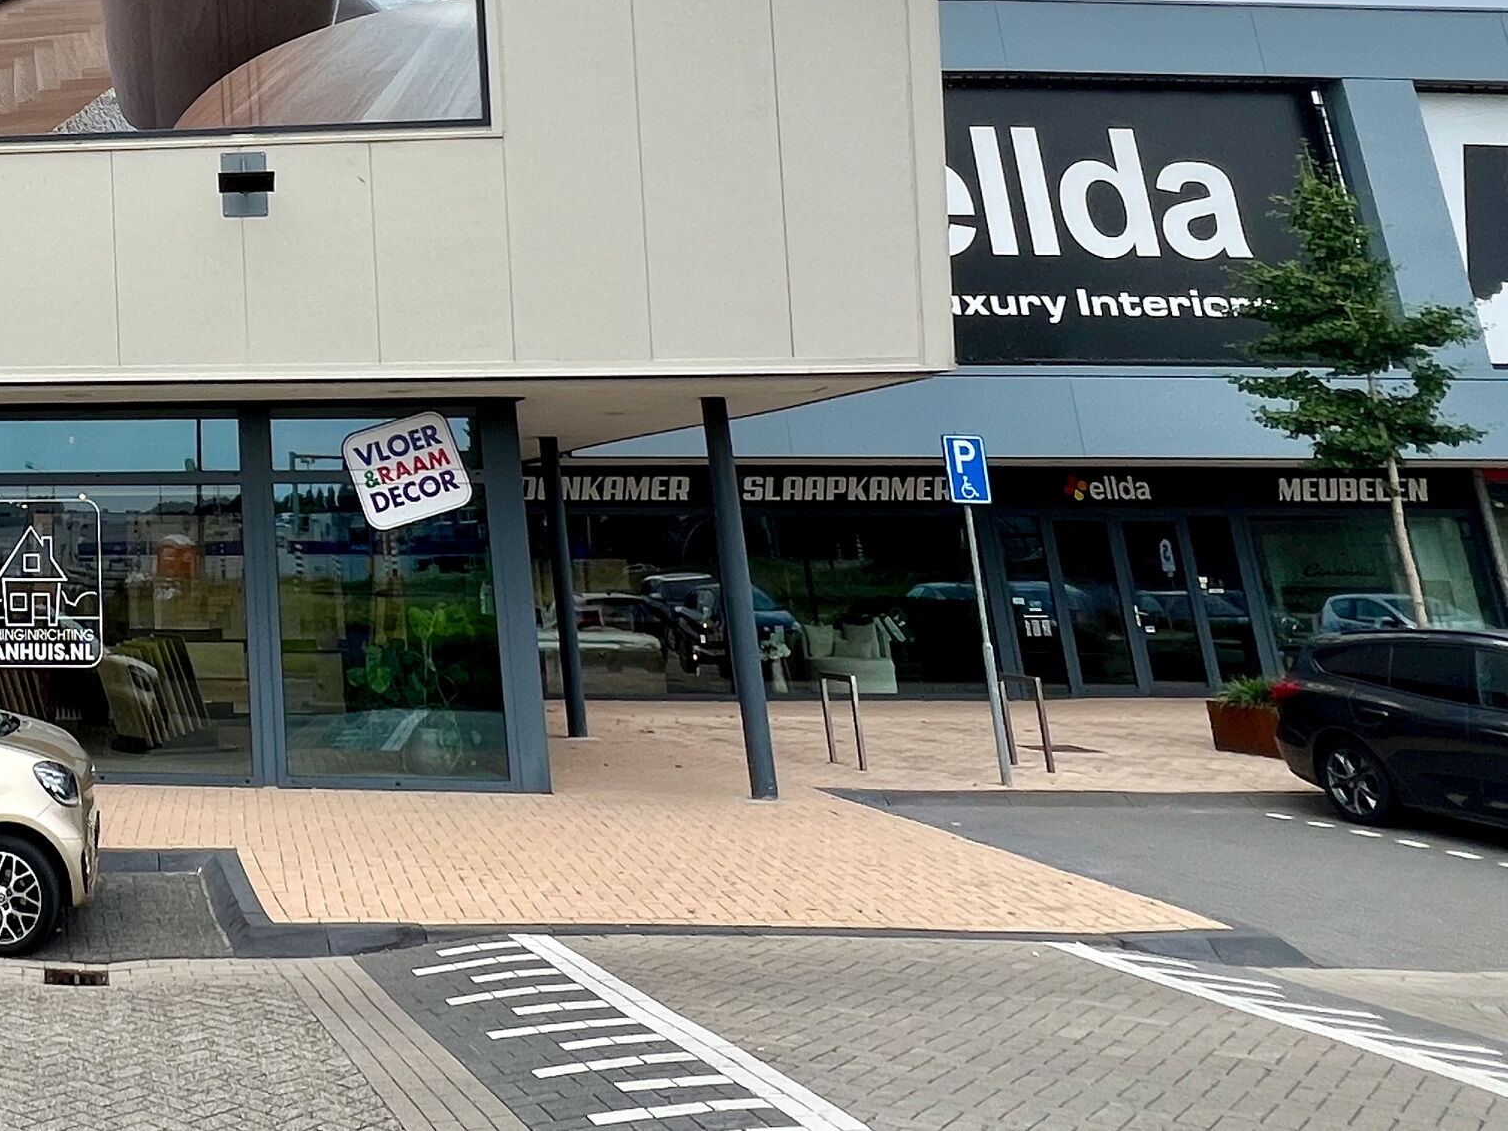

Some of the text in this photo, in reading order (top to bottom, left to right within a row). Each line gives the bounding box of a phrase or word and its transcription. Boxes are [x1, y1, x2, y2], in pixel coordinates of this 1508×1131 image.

[1076, 287, 1280, 319] Interior
[352, 424, 443, 466] VLOER
[953, 439, 976, 474] P
[364, 448, 451, 488] &RAAM
[370, 470, 461, 514] DECOR
[742, 476, 951, 501] SLAAPKAMER
[1089, 475, 1152, 500] ellda
